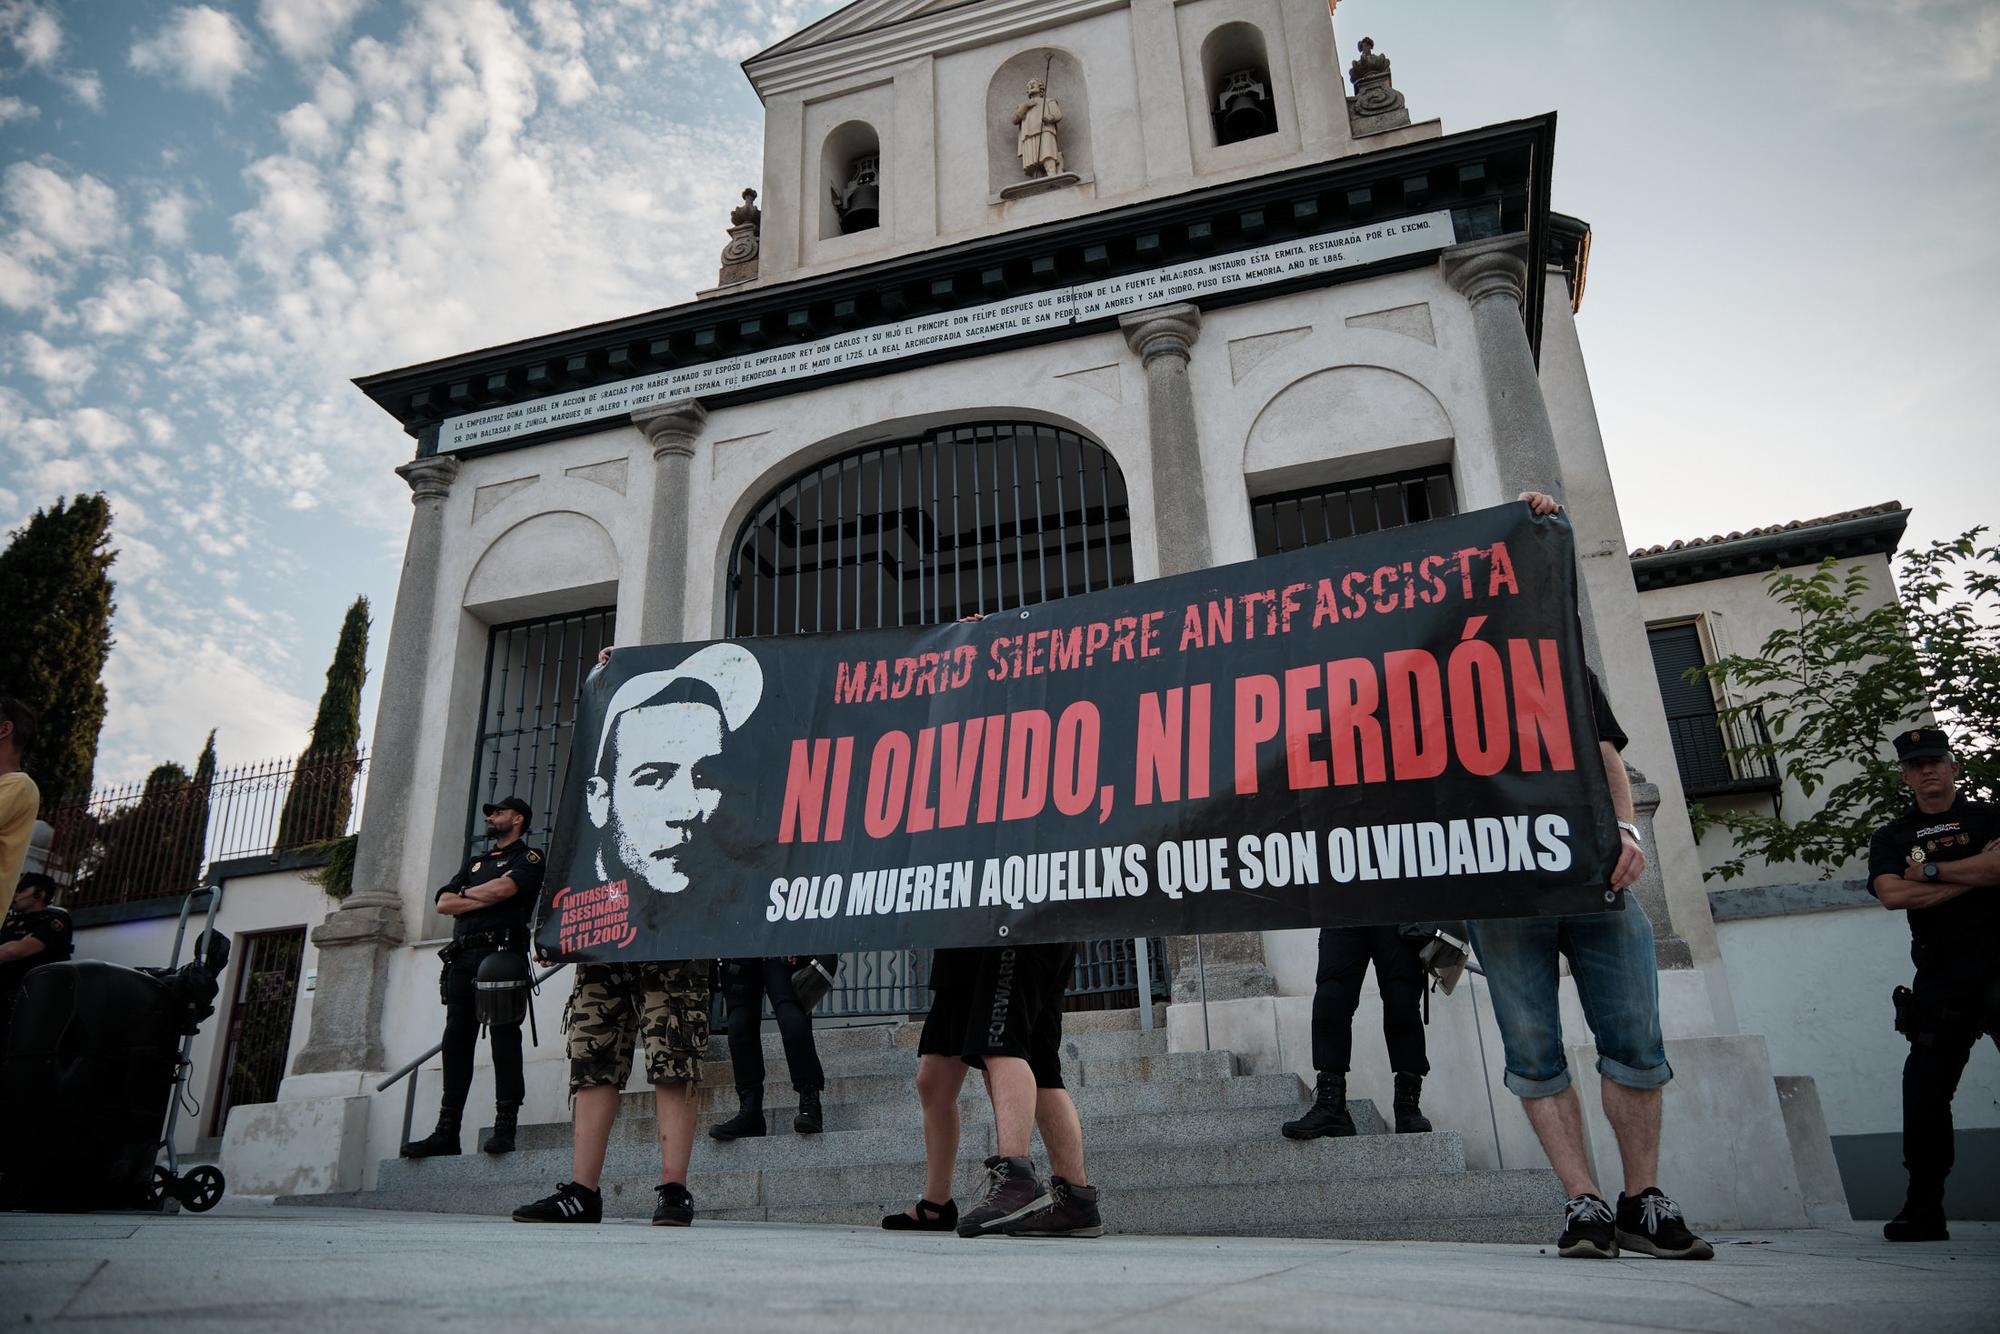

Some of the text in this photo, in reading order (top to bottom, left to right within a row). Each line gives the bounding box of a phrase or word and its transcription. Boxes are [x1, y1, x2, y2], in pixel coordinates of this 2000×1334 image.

[454, 421, 463, 431] LA
[466, 412, 504, 428] EMPERATRIZ
[506, 407, 523, 420] DOÑA
[526, 403, 547, 415] ISABEL
[551, 400, 559, 410] EN
[562, 395, 585, 408] ACCION
[588, 392, 597, 402] DE
[630, 382, 644, 392] POR
[647, 377, 668, 389] HABER
[671, 371, 699, 384] SANADO
[702, 368, 712, 378] SU
[715, 362, 741, 375] ESPOSO
[744, 360, 752, 369] EL
[755, 351, 796, 367] EMPERADOR
[799, 347, 813, 358] REY
[816, 343, 830, 355] DON
[833, 336, 860, 350] CARLOS
[863, 334, 868, 344] Y
[872, 331, 881, 342] SU
[885, 327, 901, 339] HIJO
[905, 325, 913, 335] EL
[917, 318, 949, 333] PRINCIPE
[953, 314, 968, 325] DON
[972, 308, 996, 322] FELIPE
[1000, 300, 1033, 316] DESPUES
[1037, 296, 1052, 308] QUE
[1057, 289, 1093, 304] BEBIERON
[1096, 286, 1106, 296] DE
[1110, 283, 1121, 293] LA
[1125, 275, 1155, 290] FUENTE
[1209, 256, 1246, 273] INSTAURO
[1250, 252, 1270, 264] ESTA
[1274, 244, 1306, 259] ERMITA.
[1309, 233, 1361, 252] RESTAURADA
[1365, 229, 1382, 241] POR
[1386, 226, 1397, 237] EL
[465, 430, 477, 441] DON
[480, 423, 511, 438] BALTASAR
[513, 421, 522, 431] DE
[550, 408, 580, 423] MARQUES
[583, 406, 592, 416] DE
[596, 400, 620, 413] VALERO
[623, 398, 628, 407] Y
[631, 393, 654, 405] VIRREY
[657, 390, 666, 400] DE
[669, 385, 690, 398] NUEVA
[724, 376, 737, 386] FUE
[741, 367, 777, 383] BENDECIDA
[781, 365, 786, 375] A
[789, 364, 796, 373] 11
[799, 361, 808, 371] DE
[811, 356, 830, 369] MAYO
[833, 353, 842, 364] DE
[867, 346, 877, 357] LA
[882, 342, 900, 354] REAL
[904, 329, 961, 350] ARCHICOFRADIA
[965, 318, 1017, 338] SACRAMENTAL
[1021, 315, 1030, 326] DE
[1034, 311, 1050, 323] SAN
[1054, 305, 1081, 320] PEDRO,
[1084, 302, 1100, 314] SAN
[1104, 294, 1134, 309] ANDRES
[1137, 293, 1143, 303] Y
[1147, 288, 1164, 300] SAN
[1197, 277, 1217, 290] PUSO
[1221, 272, 1241, 285] ESTA
[1288, 258, 1304, 271] AÑO
[1309, 256, 1319, 267] DE
[835, 542, 1518, 703] MADRID SIEMPRE ANTIFASCISTA
[778, 616, 1575, 843] NI OLVIDO, NI PERDÓN
[561, 896, 629, 926] ASESINADO
[563, 879, 628, 910] ANTIFASCISTA
[766, 814, 1571, 922] SOLO MUEREN AQUELLXS QUE SON OLVIDADXS
[560, 912, 628, 939] por un militar
[560, 922, 628, 954] 11.11.2007
[988, 948, 1017, 1048] FORWARD
